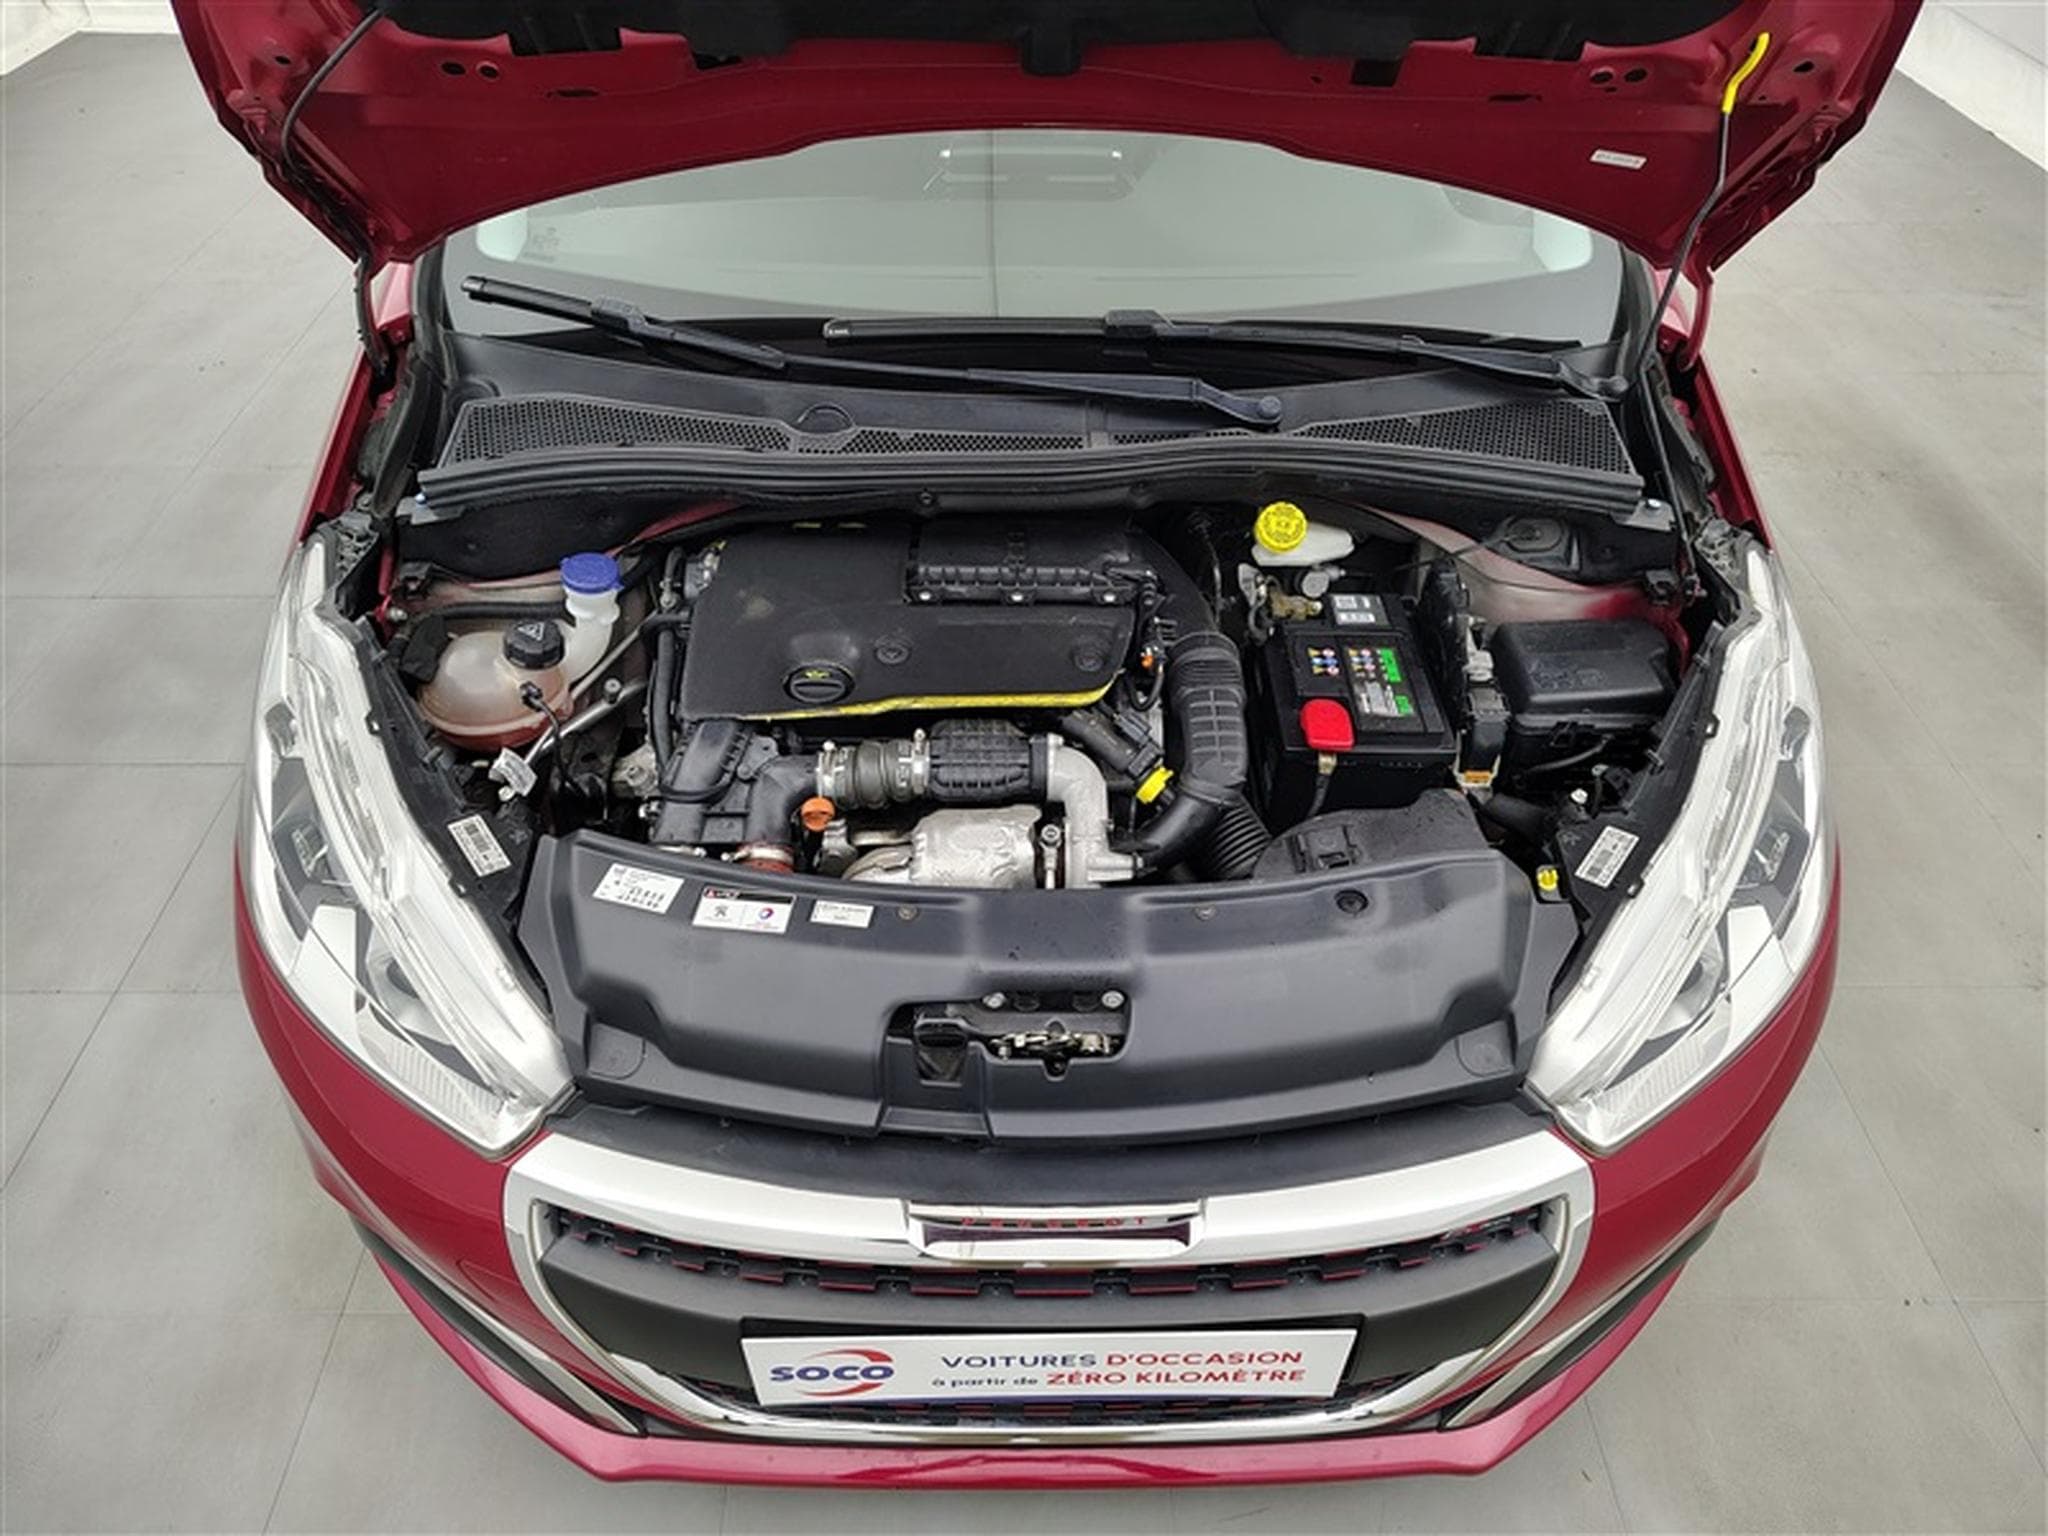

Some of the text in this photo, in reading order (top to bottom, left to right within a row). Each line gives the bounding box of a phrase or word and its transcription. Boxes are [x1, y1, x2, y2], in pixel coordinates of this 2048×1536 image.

[941, 1351, 1303, 1369] VOITURES D'OCCASION
[770, 1365, 895, 1382] SOCO
[951, 1376, 1006, 1389] partir
[1012, 1376, 1039, 1386] de
[1046, 1369, 1128, 1386] ZÉRO
